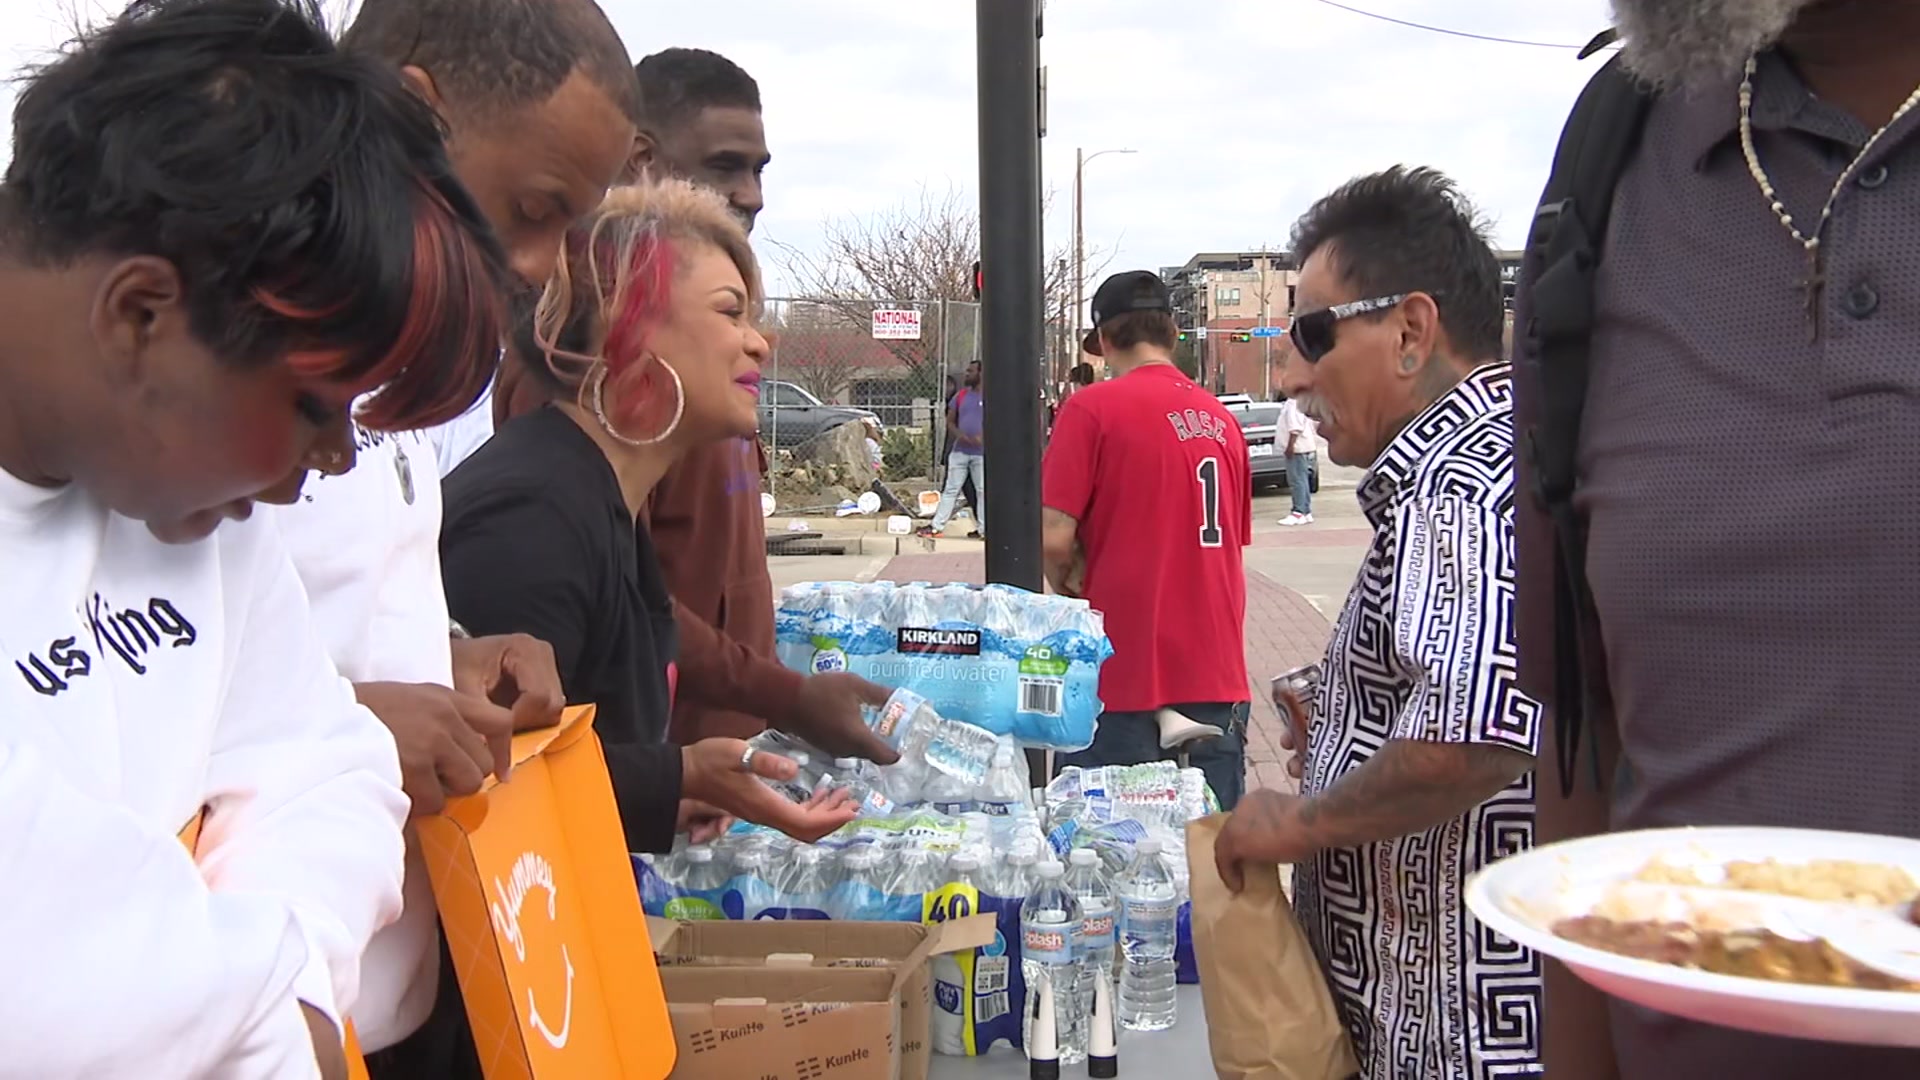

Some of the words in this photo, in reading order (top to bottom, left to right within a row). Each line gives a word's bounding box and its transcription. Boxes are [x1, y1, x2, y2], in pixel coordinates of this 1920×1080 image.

[874, 311, 918, 324] NATIONAL
[1167, 409, 1227, 445] ROSE
[1197, 457, 1222, 547] 1
[85, 590, 197, 675] King
[902, 630, 978, 645] KIRKLAND
[1026, 647, 1051, 660] 40
[869, 661, 945, 680] purified
[952, 665, 1007, 682] water
[929, 893, 970, 924] 40
[720, 1021, 764, 1041] KunHe
[825, 1048, 869, 1069] KunHe
